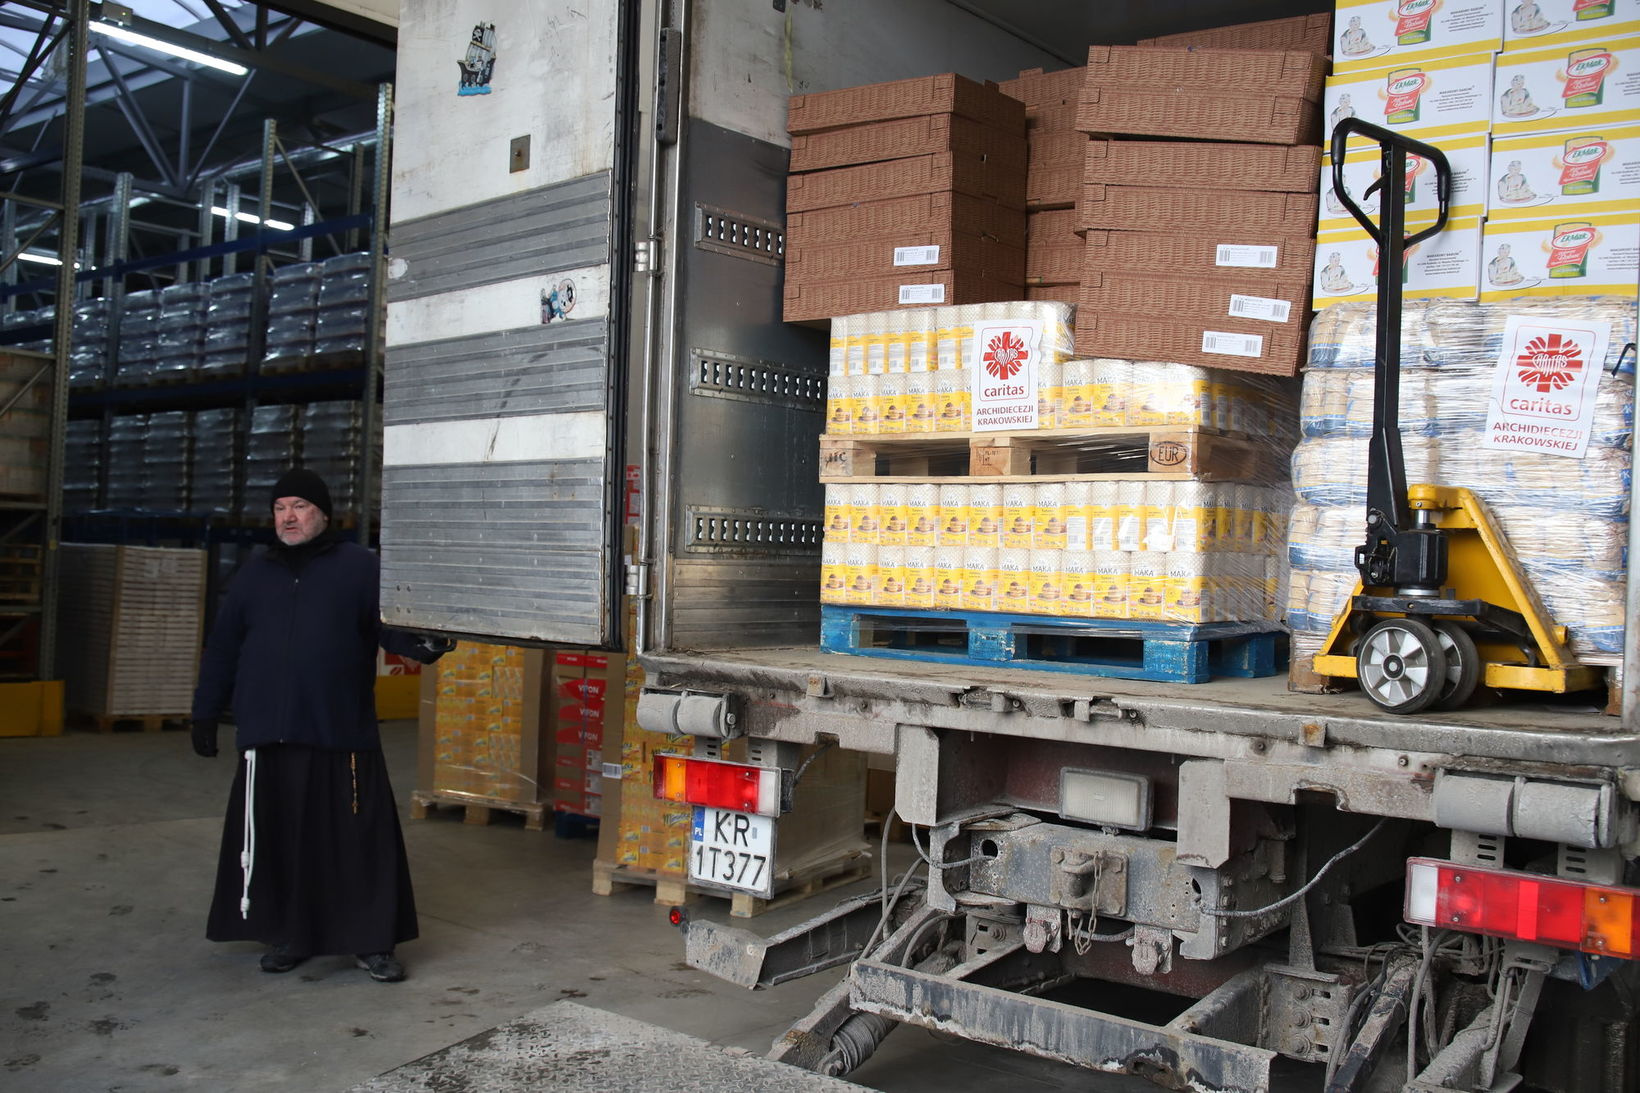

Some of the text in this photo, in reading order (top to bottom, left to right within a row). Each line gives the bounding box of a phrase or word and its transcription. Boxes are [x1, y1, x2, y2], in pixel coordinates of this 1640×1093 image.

[984, 384, 1024, 397] caritas
[976, 405, 1034, 416] ARCHIDIECEZJI
[1510, 397, 1572, 415] caritas
[977, 415, 1033, 426] KRAKOWSKIEJ
[1493, 422, 1584, 440] ARCHIDIECEZJI
[1493, 434, 1579, 451] KRAKOWSKIEJ
[1158, 446, 1179, 462] EUR
[694, 827, 703, 837] PL
[715, 811, 750, 847] KR
[696, 845, 767, 886] 1T377
